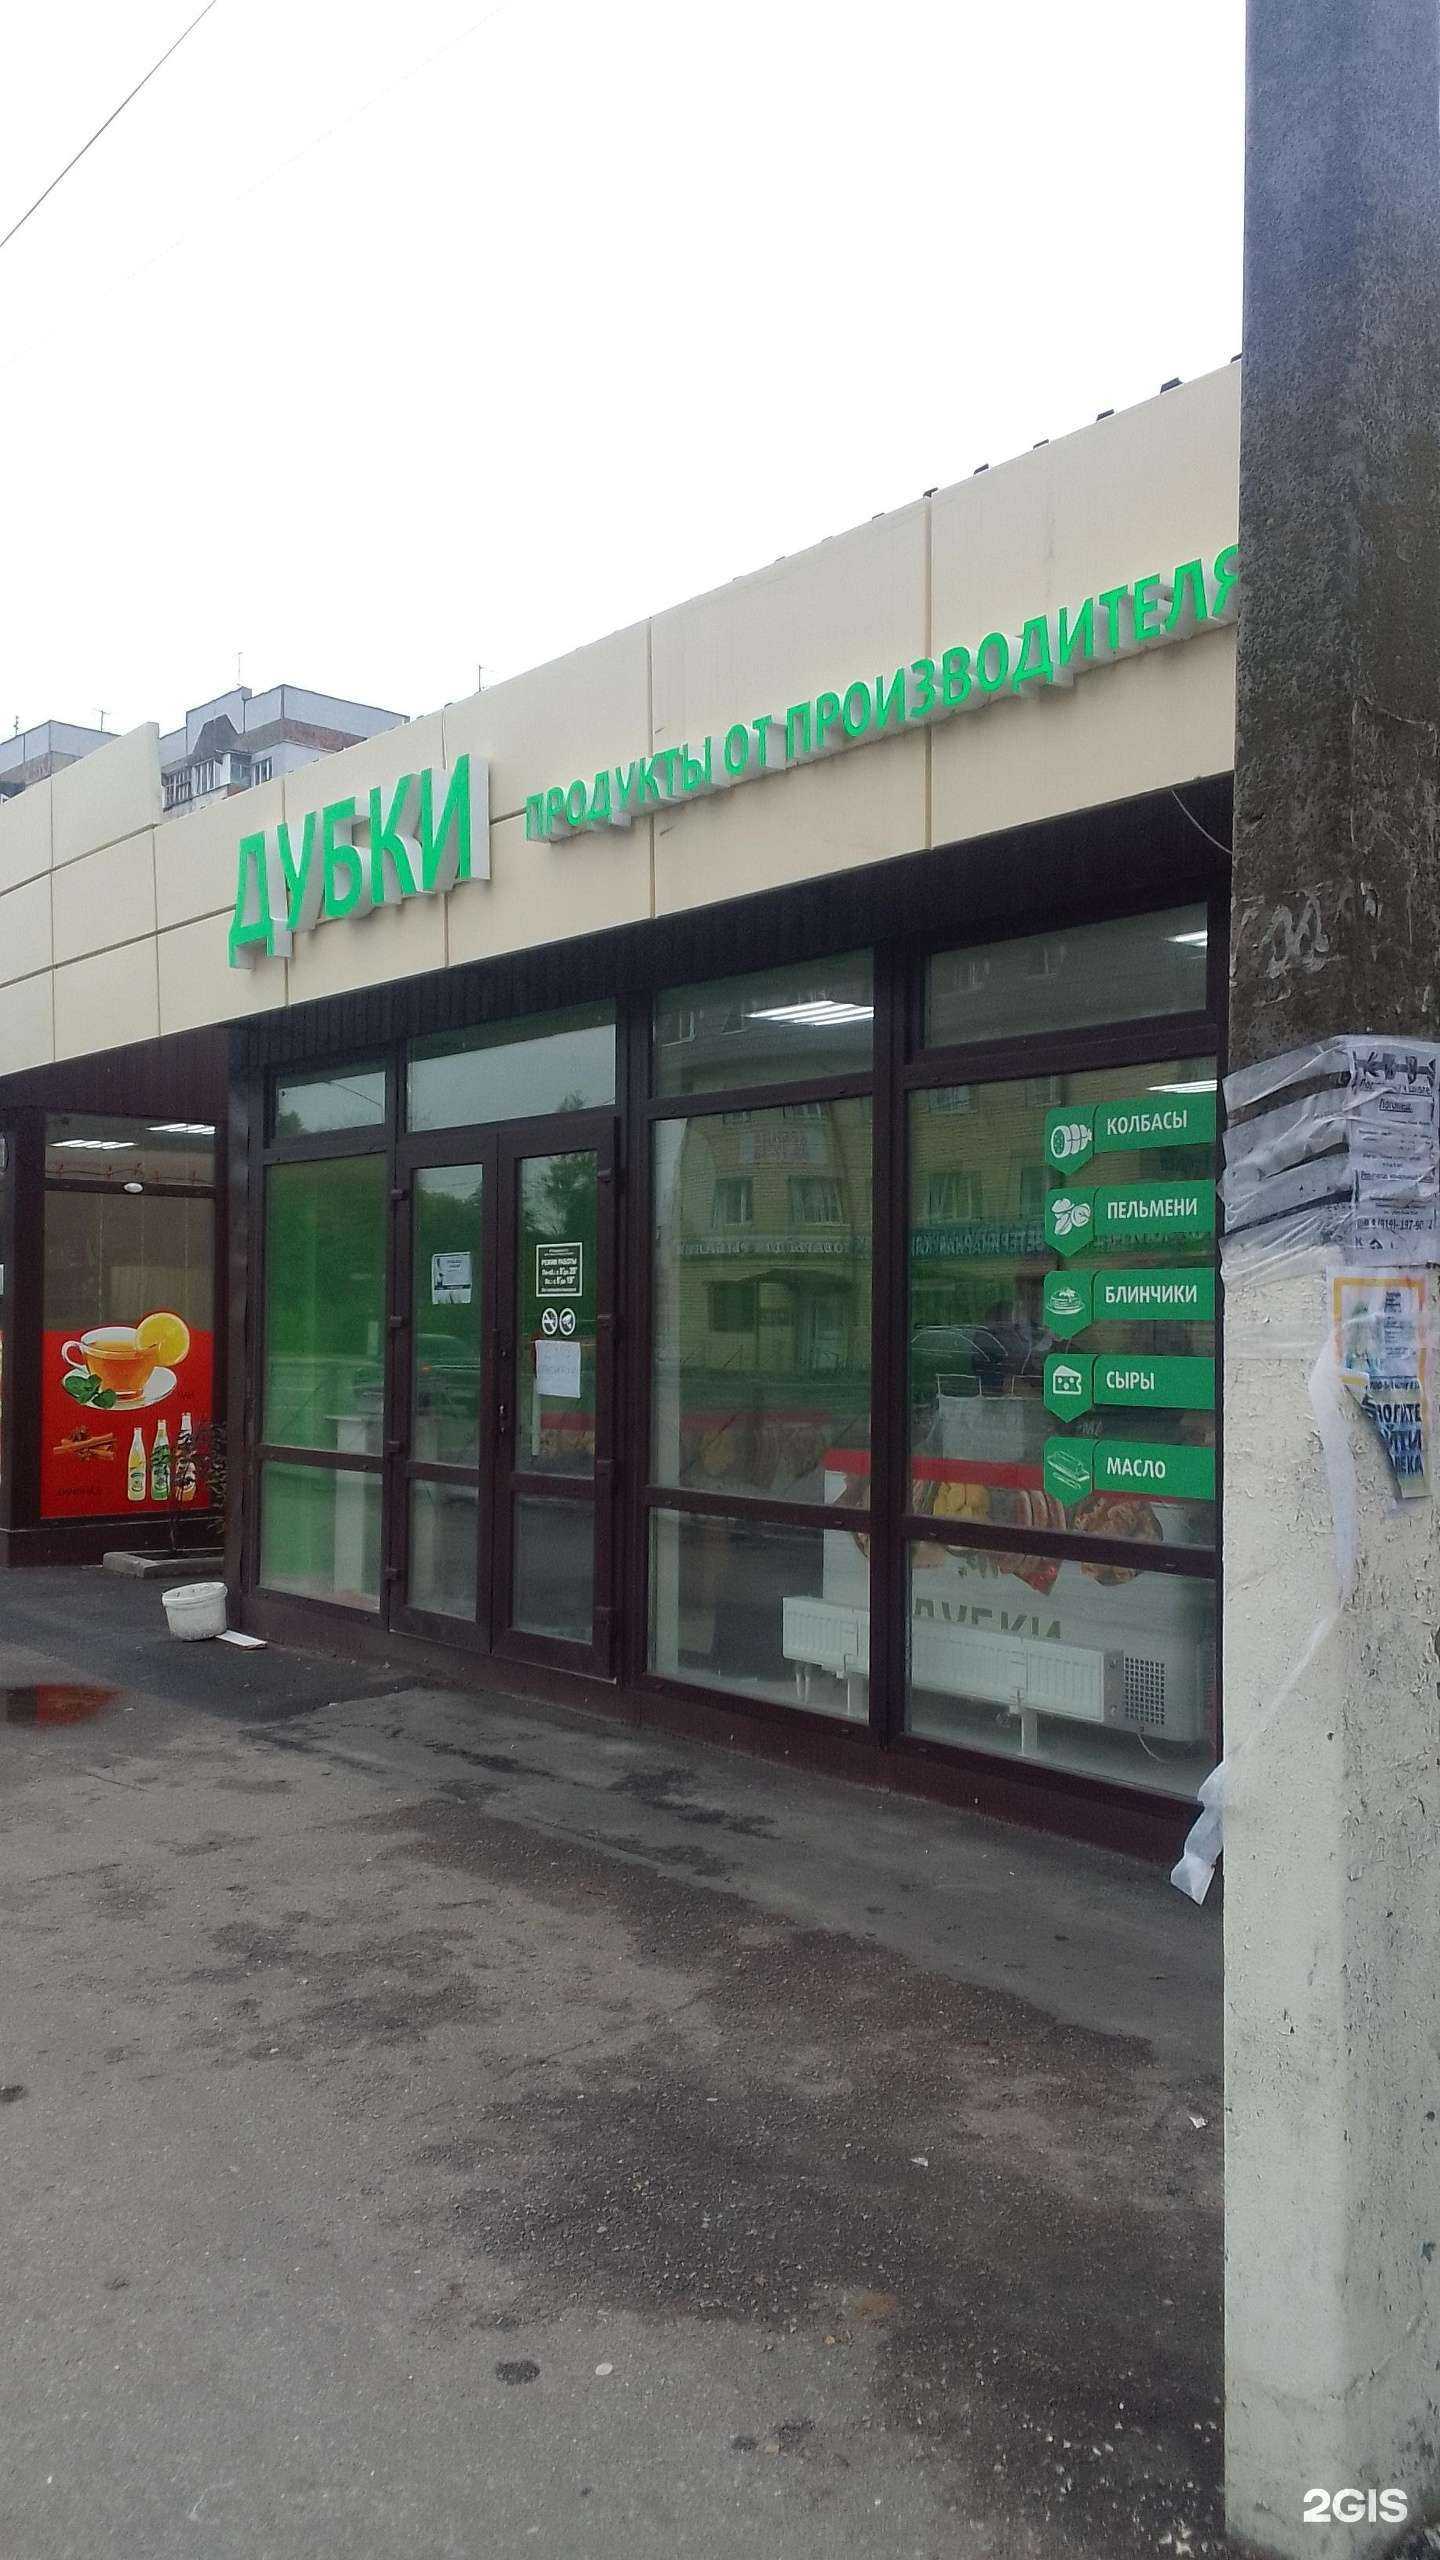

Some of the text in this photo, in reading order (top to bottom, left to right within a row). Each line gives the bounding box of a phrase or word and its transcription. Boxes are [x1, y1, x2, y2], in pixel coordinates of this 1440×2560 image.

[525, 543, 1239, 842] ПРОДУКТЫ ОТ ПРОИЗВОДИТЕЛЯ
[228, 752, 475, 969] ДУБКИ
[1106, 1110, 1188, 1136] КОЛБАСЫ
[1107, 1198, 1198, 1220] ПЕЛЬМЕНИ
[1105, 1285, 1198, 1304] БЛИНЧИКИ
[1106, 1370, 1155, 1390] СЫРЫ
[1106, 1457, 1166, 1480] МАСЛО
